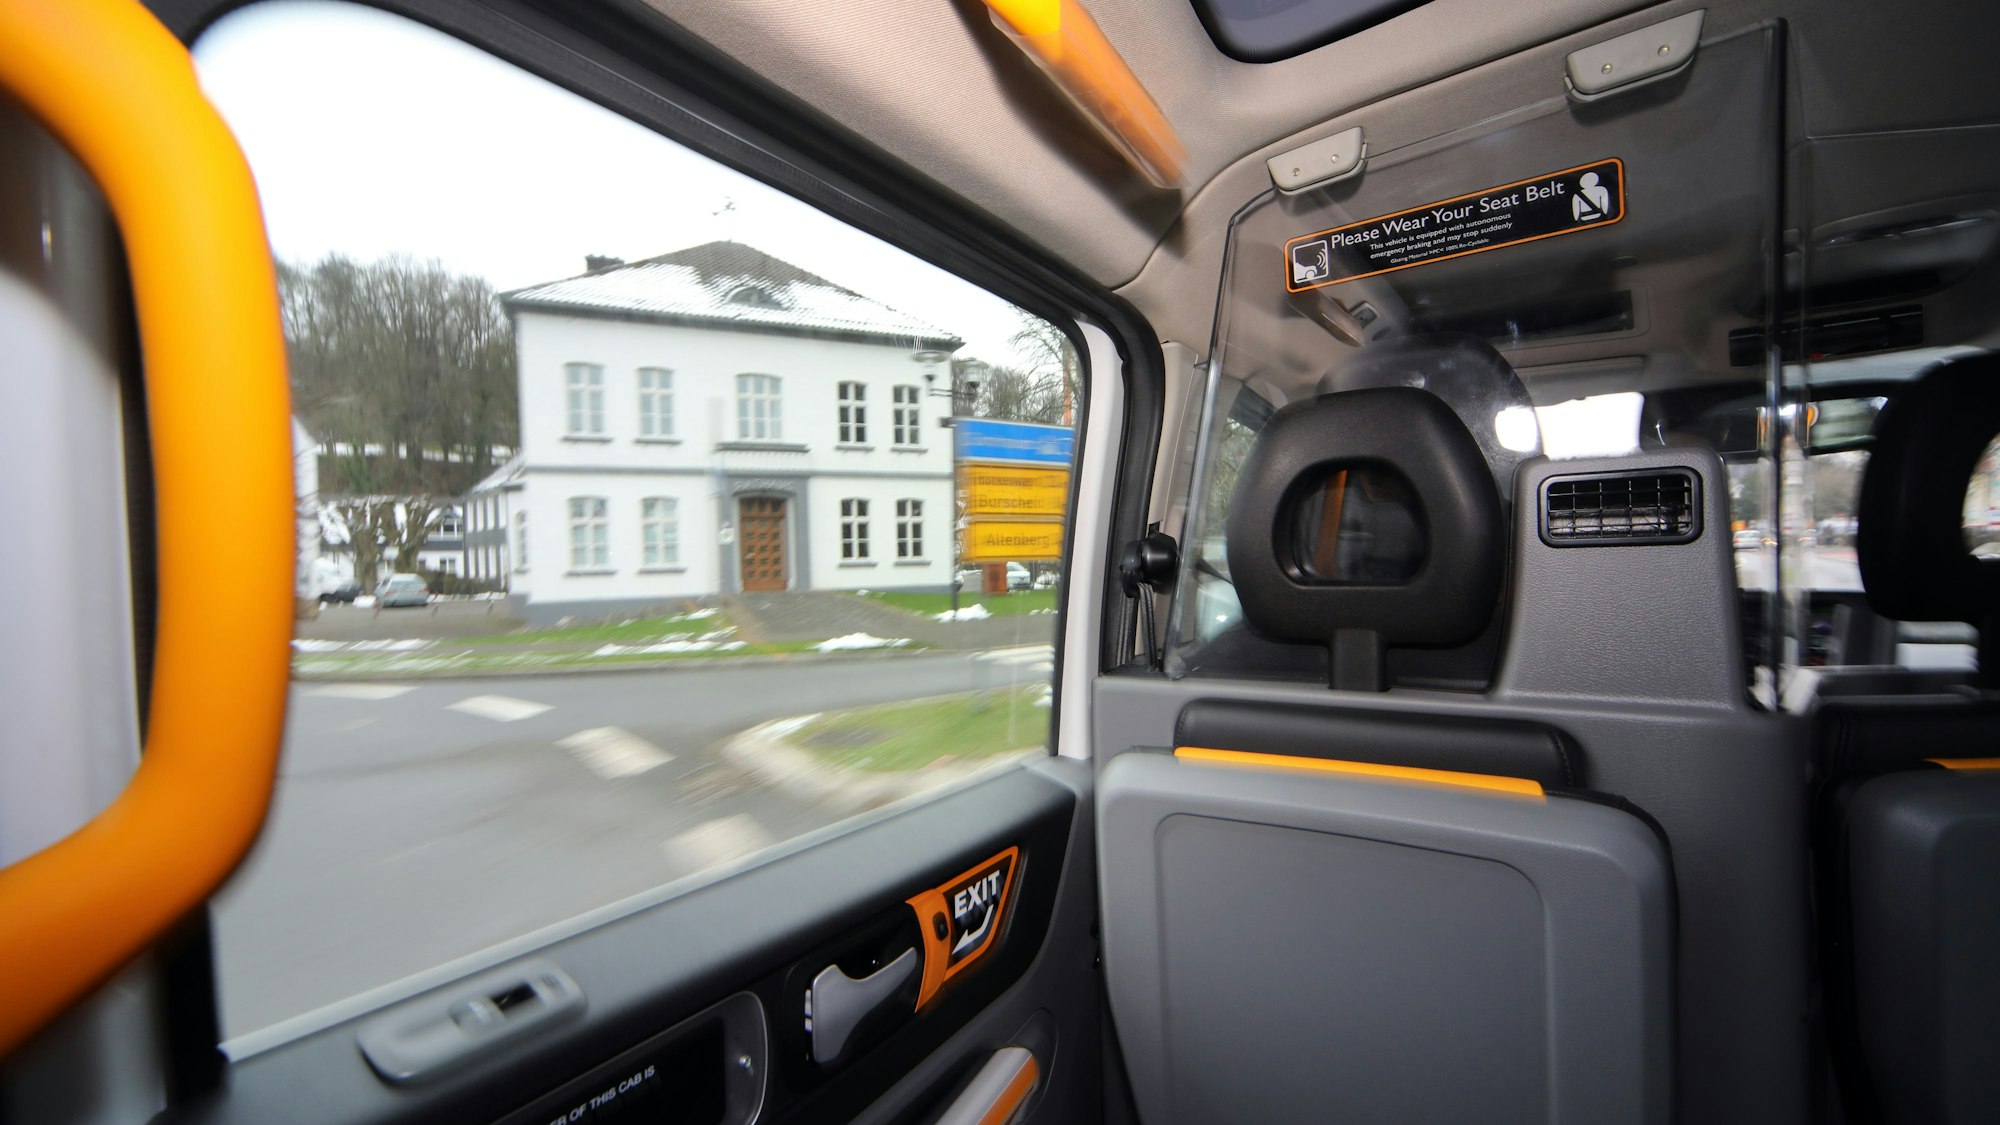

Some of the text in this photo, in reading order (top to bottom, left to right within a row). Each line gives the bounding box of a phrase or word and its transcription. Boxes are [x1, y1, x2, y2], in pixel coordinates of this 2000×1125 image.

[1331, 180, 1565, 249] Please Wear Your Seat Belt
[1370, 213, 1512, 251] This vehicle is equipped with autonomous
[1370, 221, 1513, 260] emergency braking and may stop suddenly
[954, 869, 1000, 920] EXIT
[569, 1102, 588, 1121] OF
[589, 1087, 617, 1110] THIS
[618, 1072, 643, 1093] CAB
[644, 1065, 655, 1079] IS
